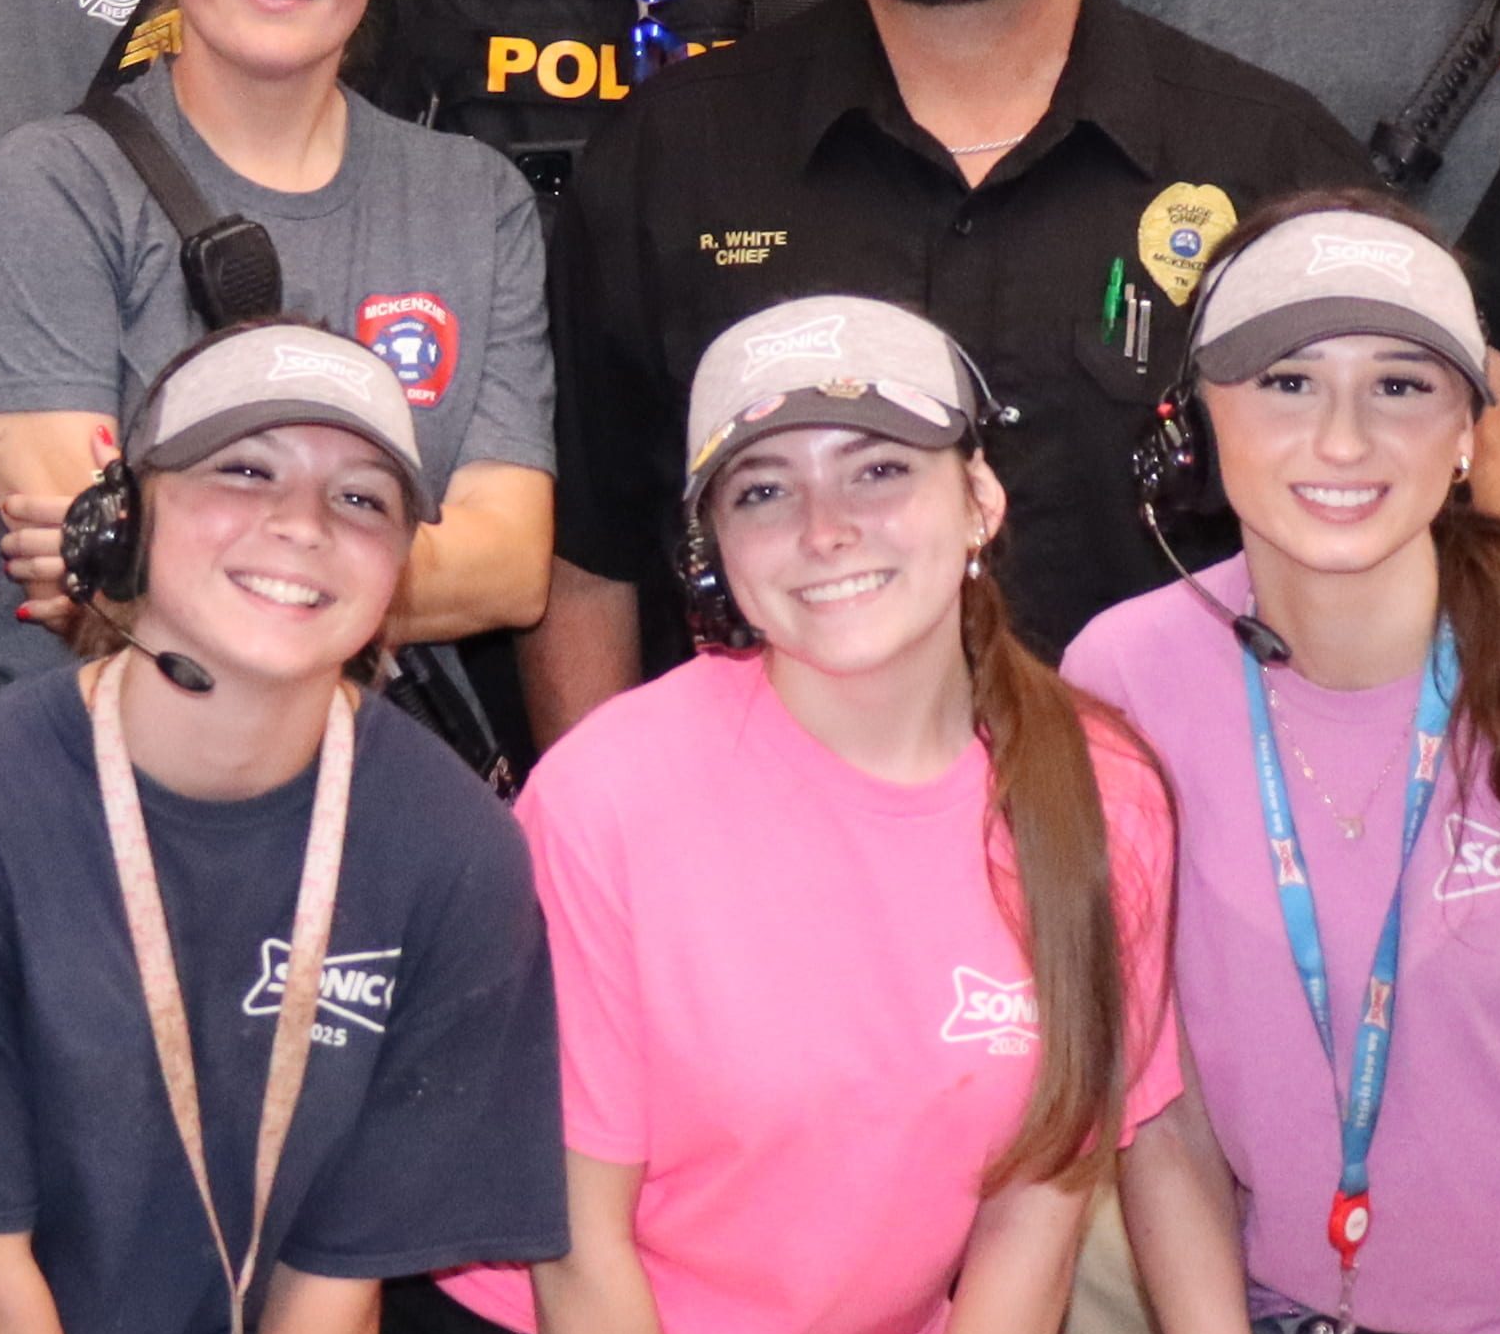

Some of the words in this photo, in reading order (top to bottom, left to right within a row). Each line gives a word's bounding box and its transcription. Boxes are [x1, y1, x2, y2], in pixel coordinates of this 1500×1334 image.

[101, 4, 135, 19] DEP
[700, 233, 719, 249] R.
[725, 231, 788, 247] WHITE
[715, 248, 771, 266] CHIEF
[1322, 245, 1401, 269] SONIC
[364, 297, 447, 325] MCKENZIE
[756, 332, 829, 358] SONIC
[284, 356, 361, 384] SONIC
[407, 388, 437, 402] DEPT
[311, 1024, 347, 1046] 025
